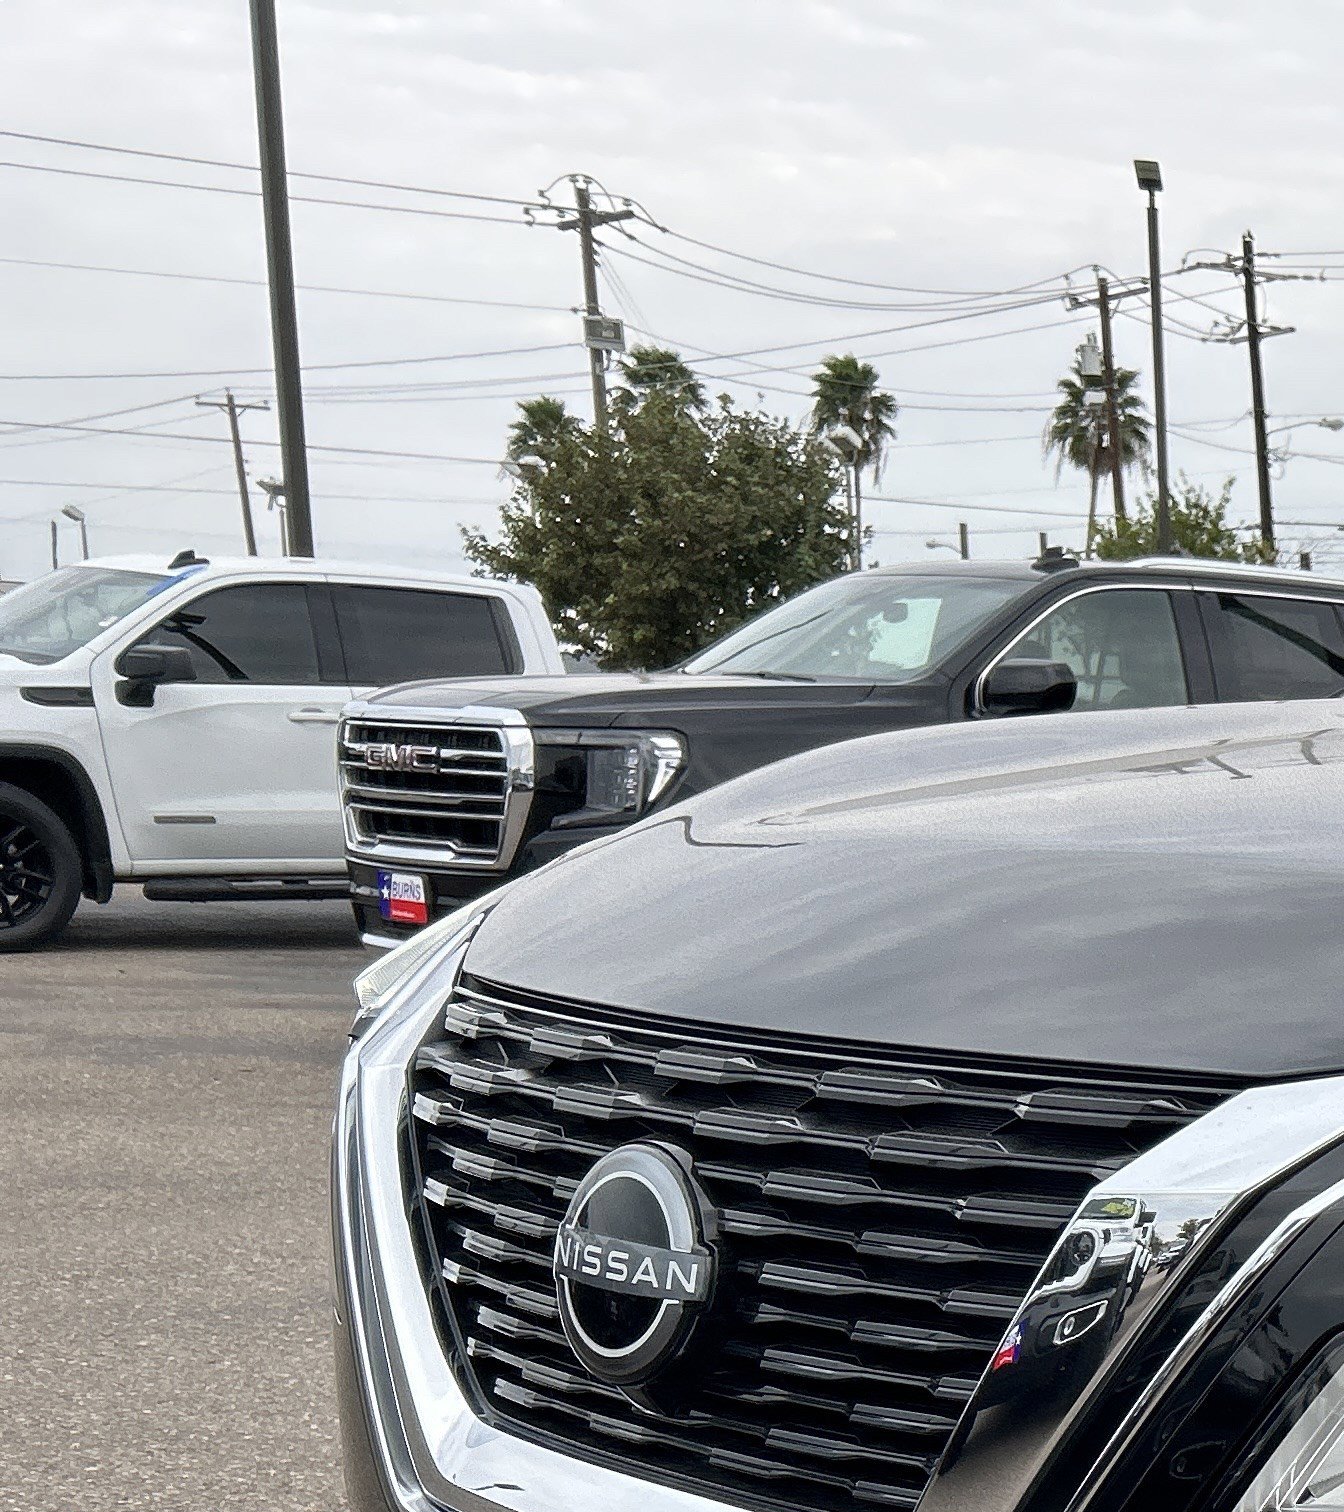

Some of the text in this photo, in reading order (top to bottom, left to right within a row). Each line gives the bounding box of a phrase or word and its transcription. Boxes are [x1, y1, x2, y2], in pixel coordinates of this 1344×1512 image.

[365, 744, 438, 774] GMC
[392, 880, 421, 901] BURNS
[553, 1234, 699, 1294] NISSAN
